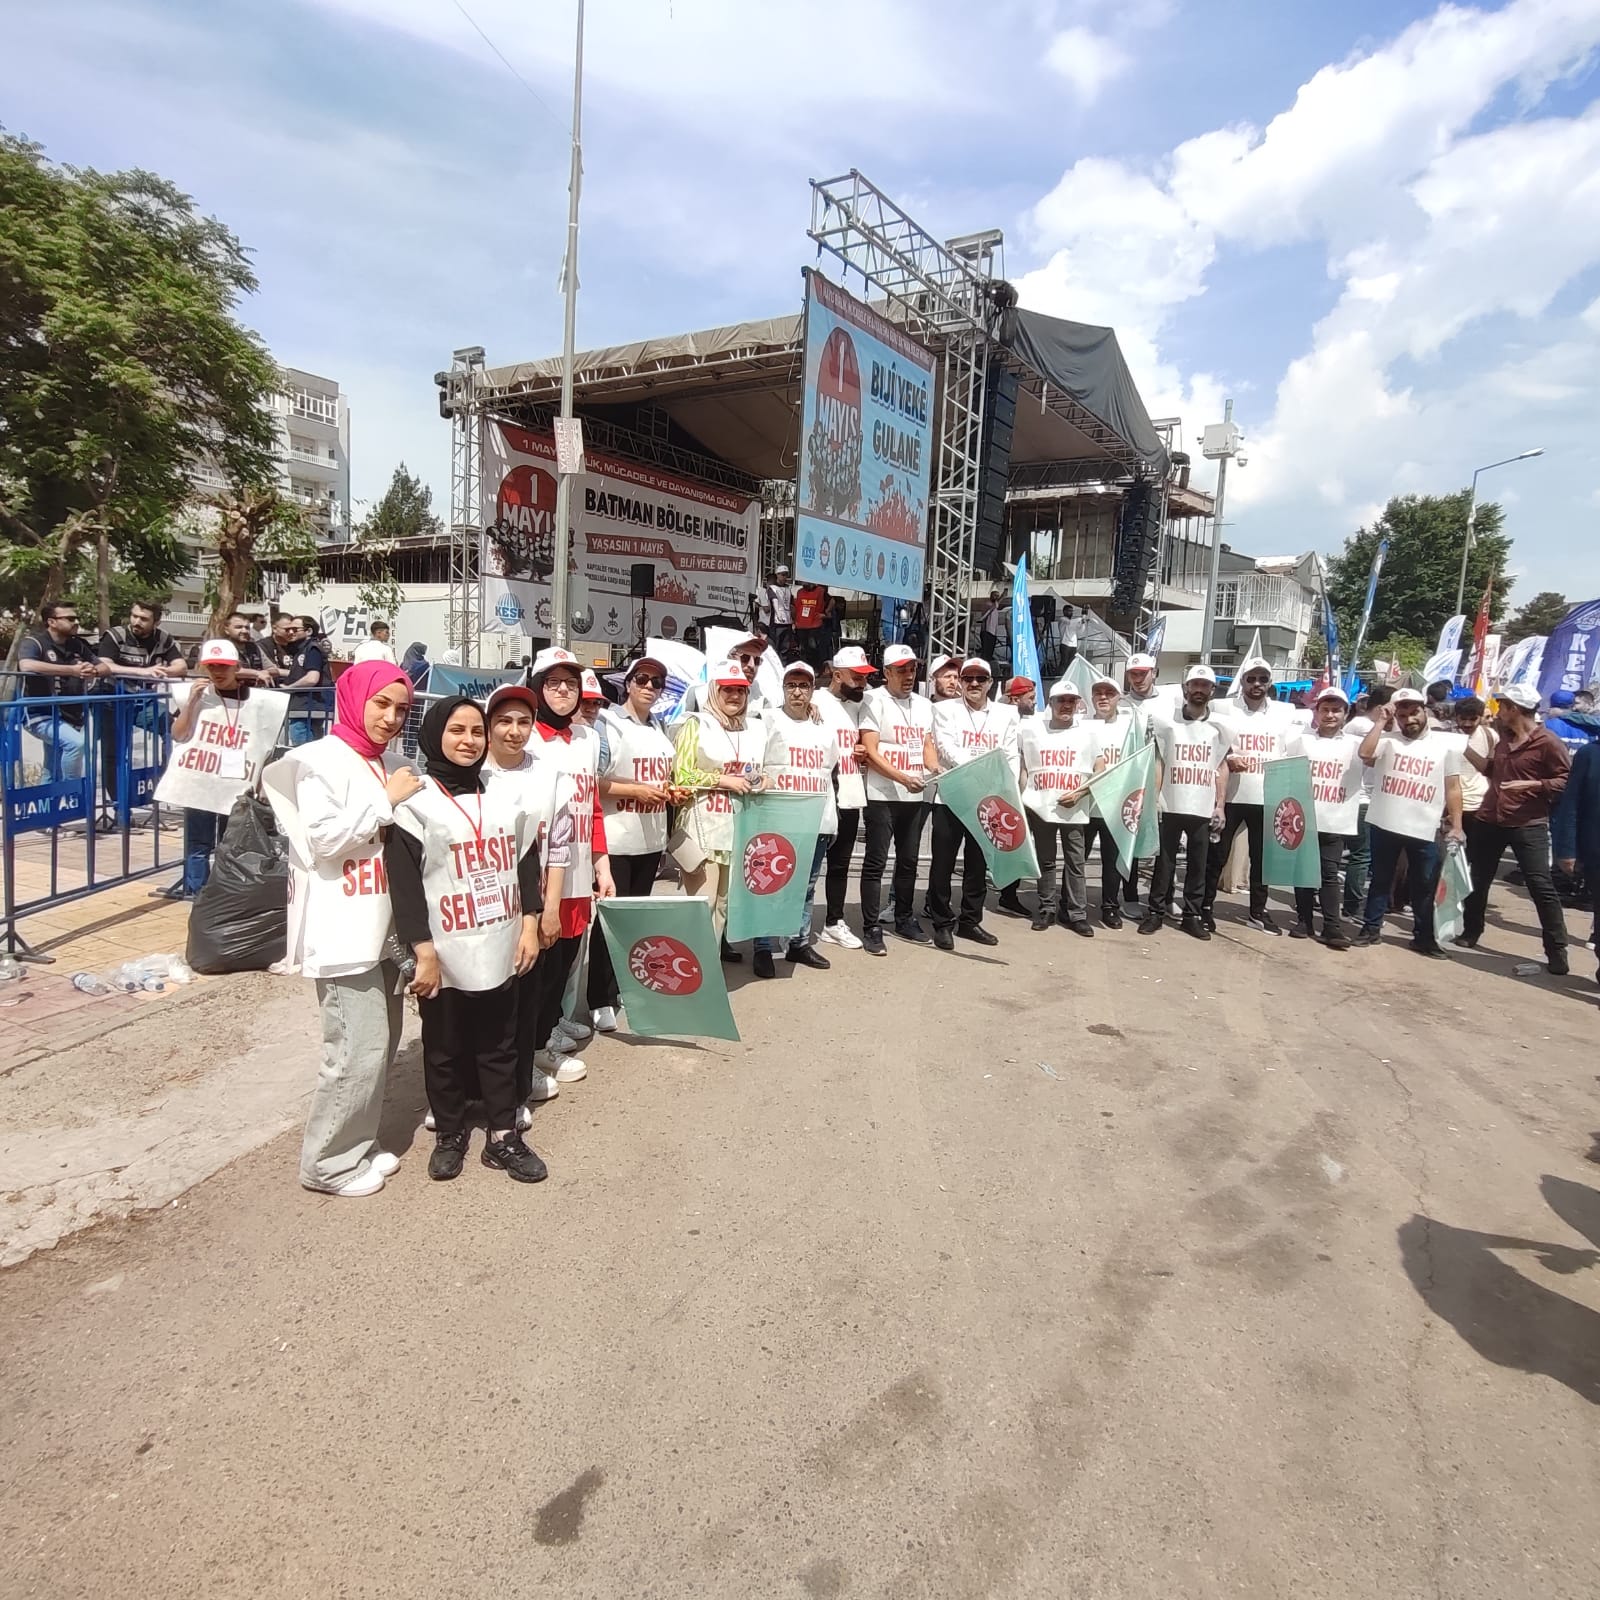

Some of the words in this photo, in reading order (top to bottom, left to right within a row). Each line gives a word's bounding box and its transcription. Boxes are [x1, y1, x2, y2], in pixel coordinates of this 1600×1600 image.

[819, 392, 858, 443] MAYIS
[872, 418, 921, 471] GULANÊ
[530, 473, 538, 505] 1
[532, 442, 557, 457] MAY
[584, 456, 603, 472] LİK,
[604, 463, 656, 485] MÜCADELE
[656, 477, 668, 488] VE
[668, 482, 716, 502] DAYANIŞMA
[716, 495, 738, 509] GÜNÜ
[502, 501, 557, 535] MAYI
[585, 487, 653, 526] BATMAN
[656, 503, 702, 537] BÖLGE
[591, 537, 631, 552] YAŞASIN
[633, 541, 638, 552] 1
[640, 542, 664, 555] MAYIS
[495, 606, 525, 619] KESK
[1560, 633, 1591, 692] KES
[789, 745, 824, 770] TEKSİF
[1040, 746, 1076, 767] TEKSİF
[1174, 740, 1212, 763] TEKSİF
[1239, 732, 1275, 752] TEKSİF
[1393, 753, 1435, 777] TEKSİF
[979, 804, 1004, 850] TEKSİF
[449, 827, 516, 879] TEKSİF
[631, 941, 664, 991] TEKSİF
